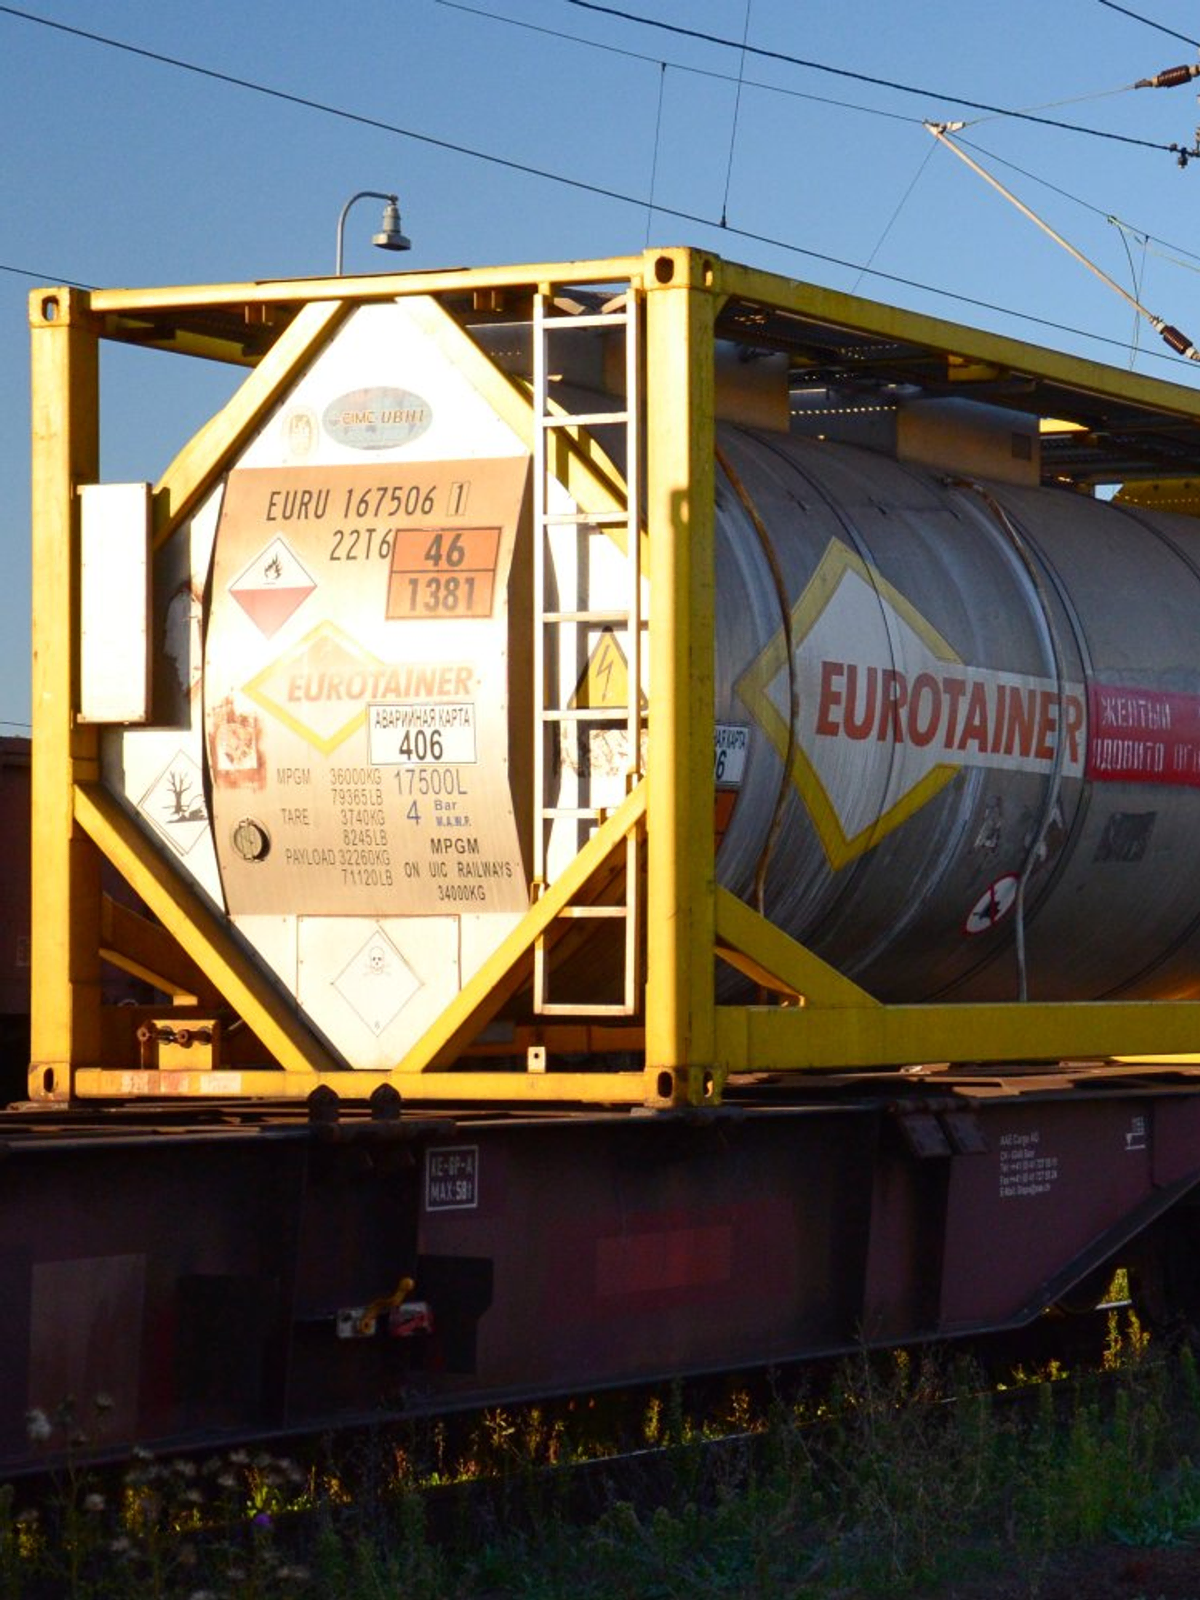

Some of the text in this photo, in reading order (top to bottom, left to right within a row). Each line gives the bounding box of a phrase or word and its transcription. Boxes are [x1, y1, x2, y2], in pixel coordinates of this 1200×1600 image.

[266, 489, 330, 521] EURU
[343, 486, 435, 519] 167506
[330, 529, 391, 562] 22T6
[425, 534, 465, 567] 46
[408, 577, 475, 612] 1381
[287, 666, 474, 702] EUROTAINER
[438, 708, 470, 728] КАРТА
[816, 660, 1084, 763] EUROTAINER
[399, 729, 443, 761] 406
[277, 768, 382, 785] MPGM 36000KG
[394, 768, 468, 796] 17500L
[331, 788, 383, 806] 79365LB
[281, 808, 385, 826] TARE 3740KG
[407, 800, 457, 825] 4 Bar
[343, 829, 388, 846] 8245LB
[430, 838, 480, 854] MPGM
[285, 848, 390, 866] PAYLOAD 32260KG
[341, 868, 393, 886] 71120LB
[404, 861, 512, 878] ON UIC RAILWAYS
[438, 885, 486, 901] 34000KG
